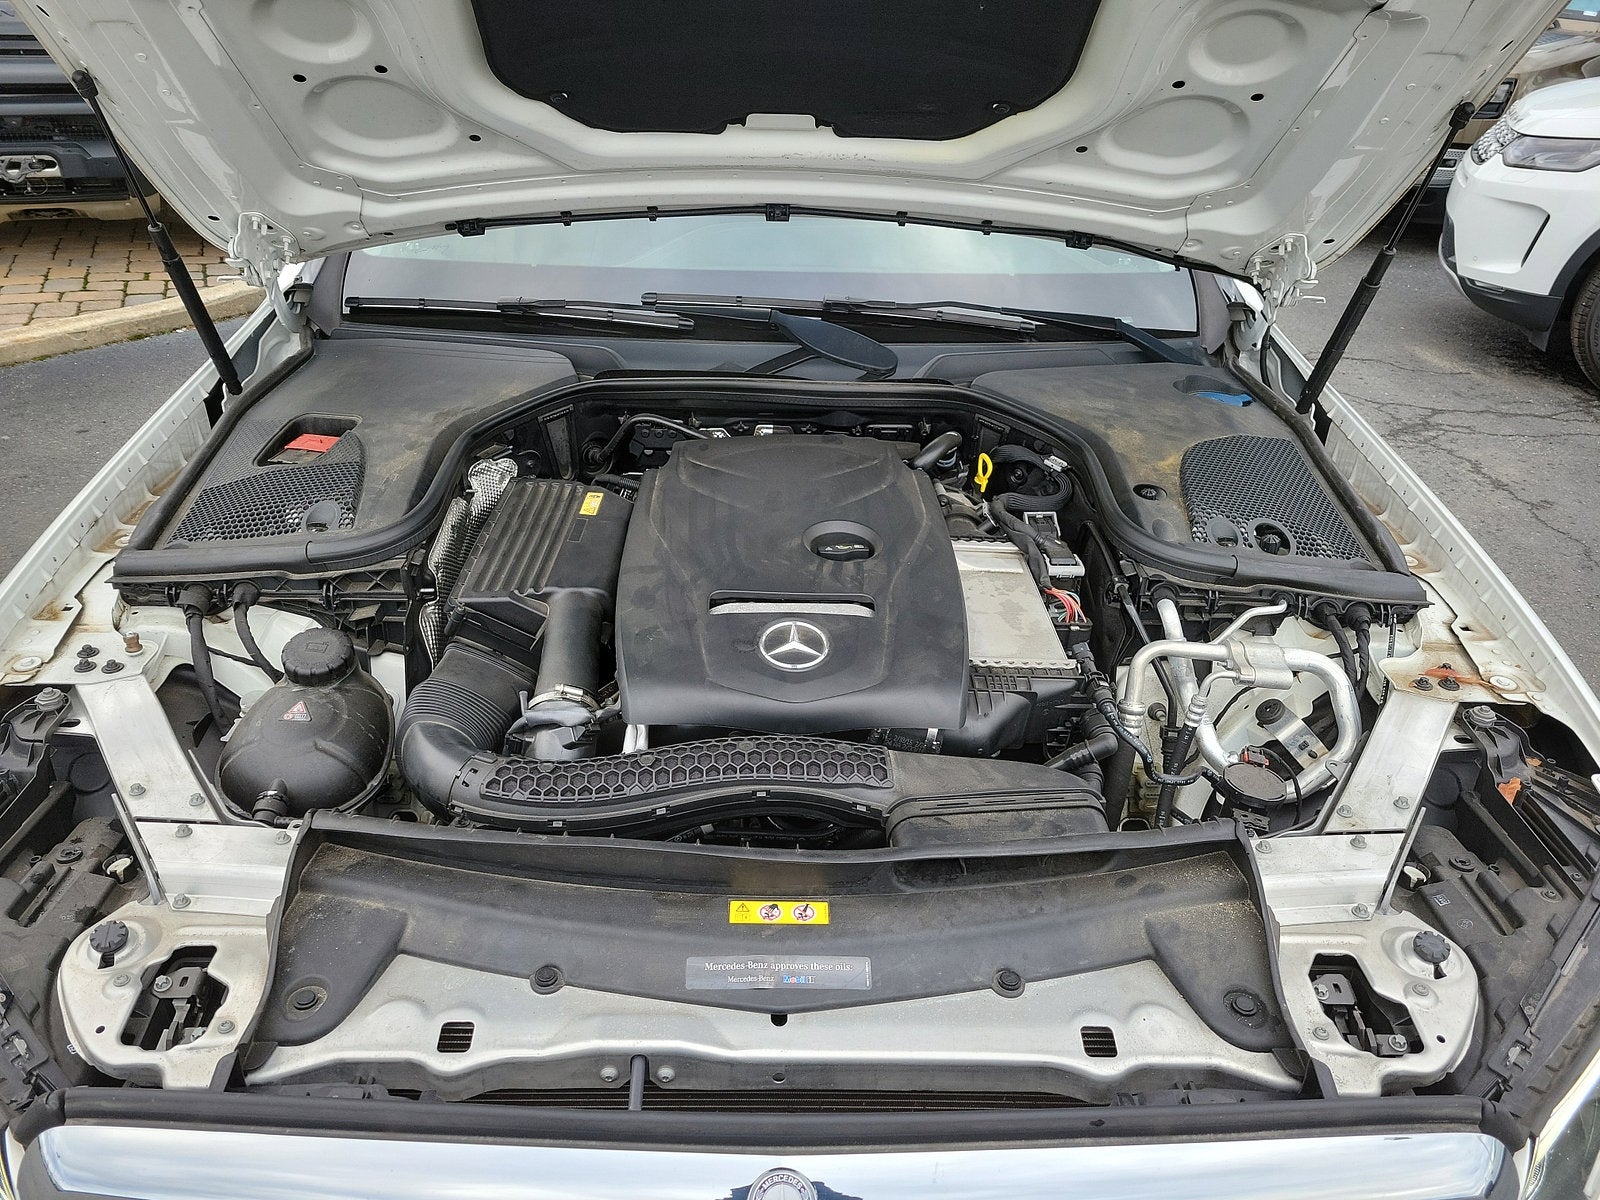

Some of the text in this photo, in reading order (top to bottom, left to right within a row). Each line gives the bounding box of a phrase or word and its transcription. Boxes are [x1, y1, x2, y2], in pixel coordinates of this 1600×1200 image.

[704, 960, 853, 972] Mercedes-Benz approves these oils:
[727, 974, 775, 984] Mercedes-Benz
[761, 1174, 803, 1190] MERCEDES
